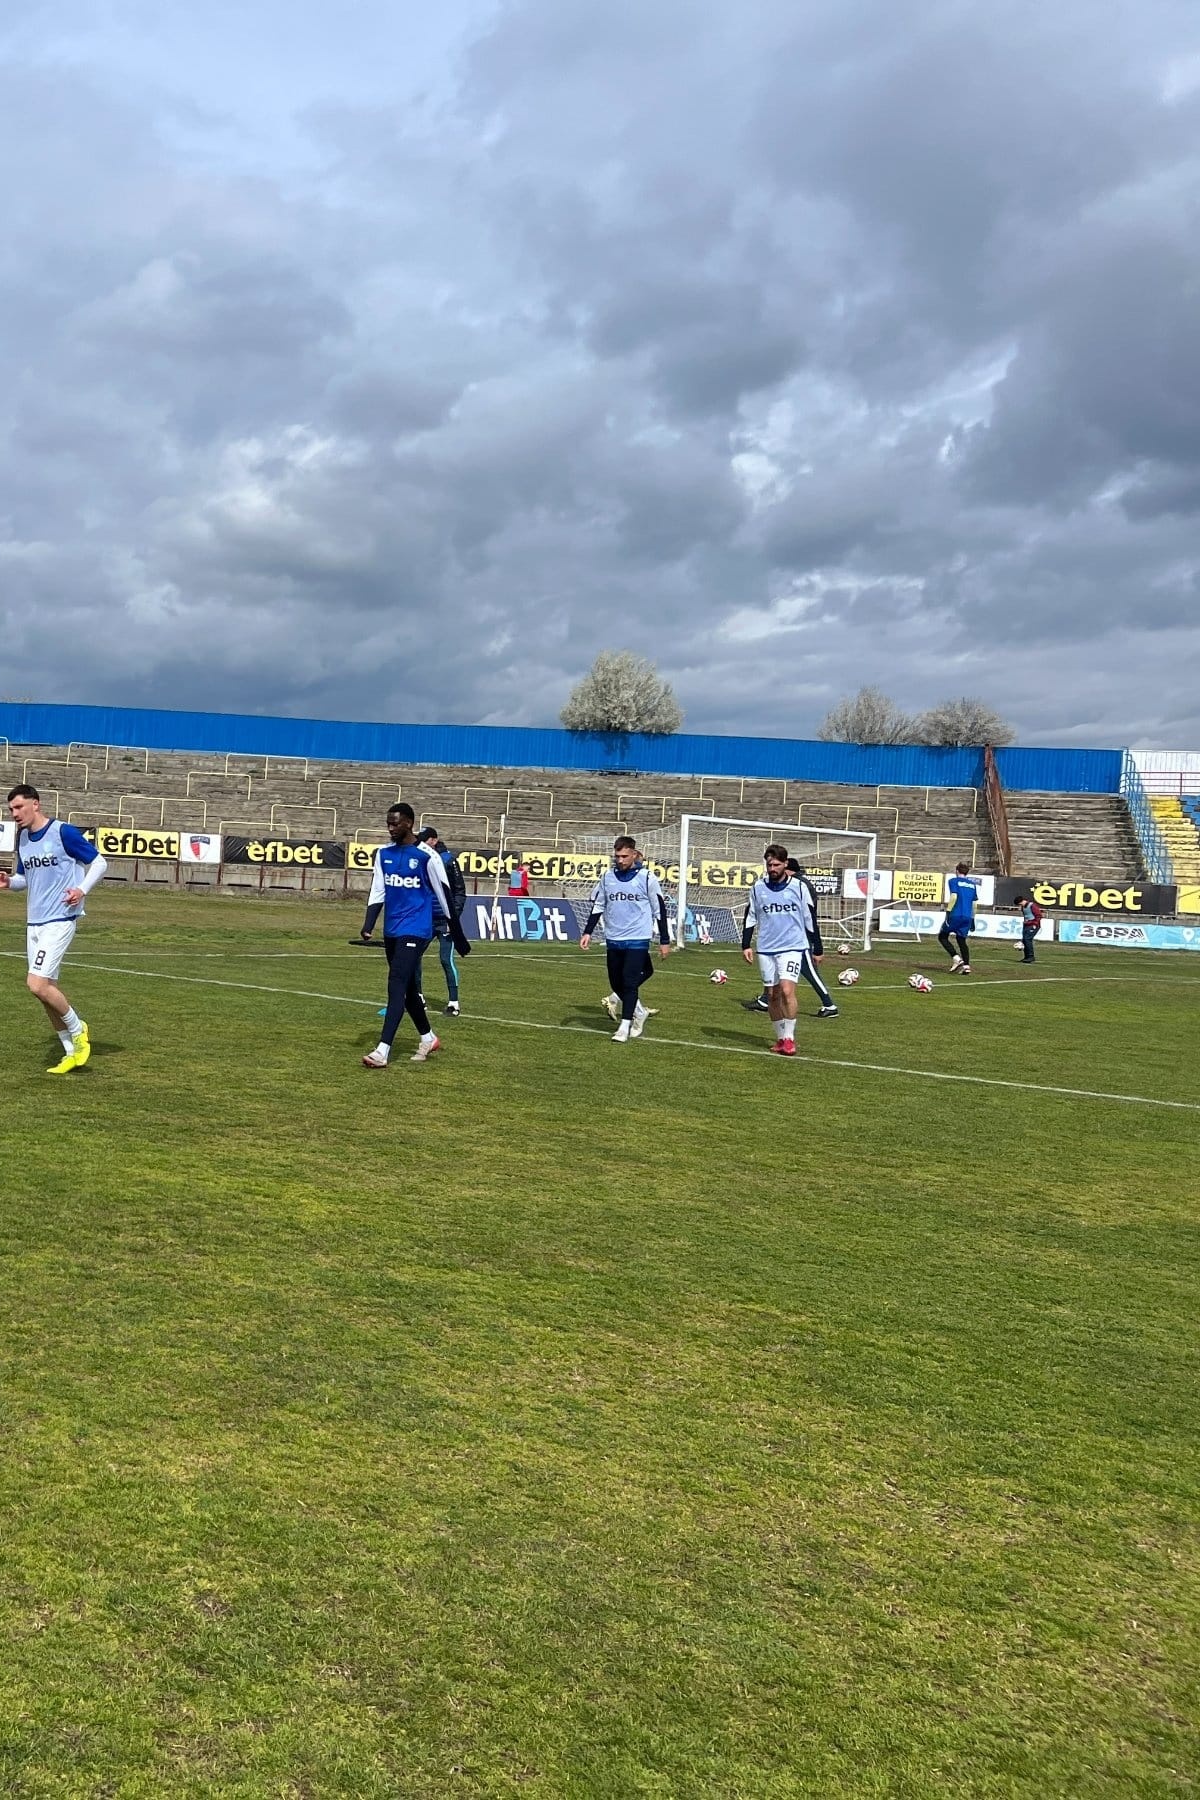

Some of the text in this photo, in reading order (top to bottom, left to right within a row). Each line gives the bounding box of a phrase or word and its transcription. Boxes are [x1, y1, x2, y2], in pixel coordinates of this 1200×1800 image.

[102, 832, 177, 856] efbet
[246, 841, 323, 865] efbet
[24, 855, 59, 870] efbet
[457, 851, 519, 876] fbet
[528, 855, 609, 879] efbet
[384, 873, 421, 888] efbet
[609, 891, 641, 902] efbet
[898, 892, 936, 900] СПОРТ
[1031, 881, 1142, 911] efbet
[762, 902, 798, 914] efbet
[476, 898, 568, 941] MrBit
[35, 949, 46, 967] 8
[786, 960, 800, 975] 66
